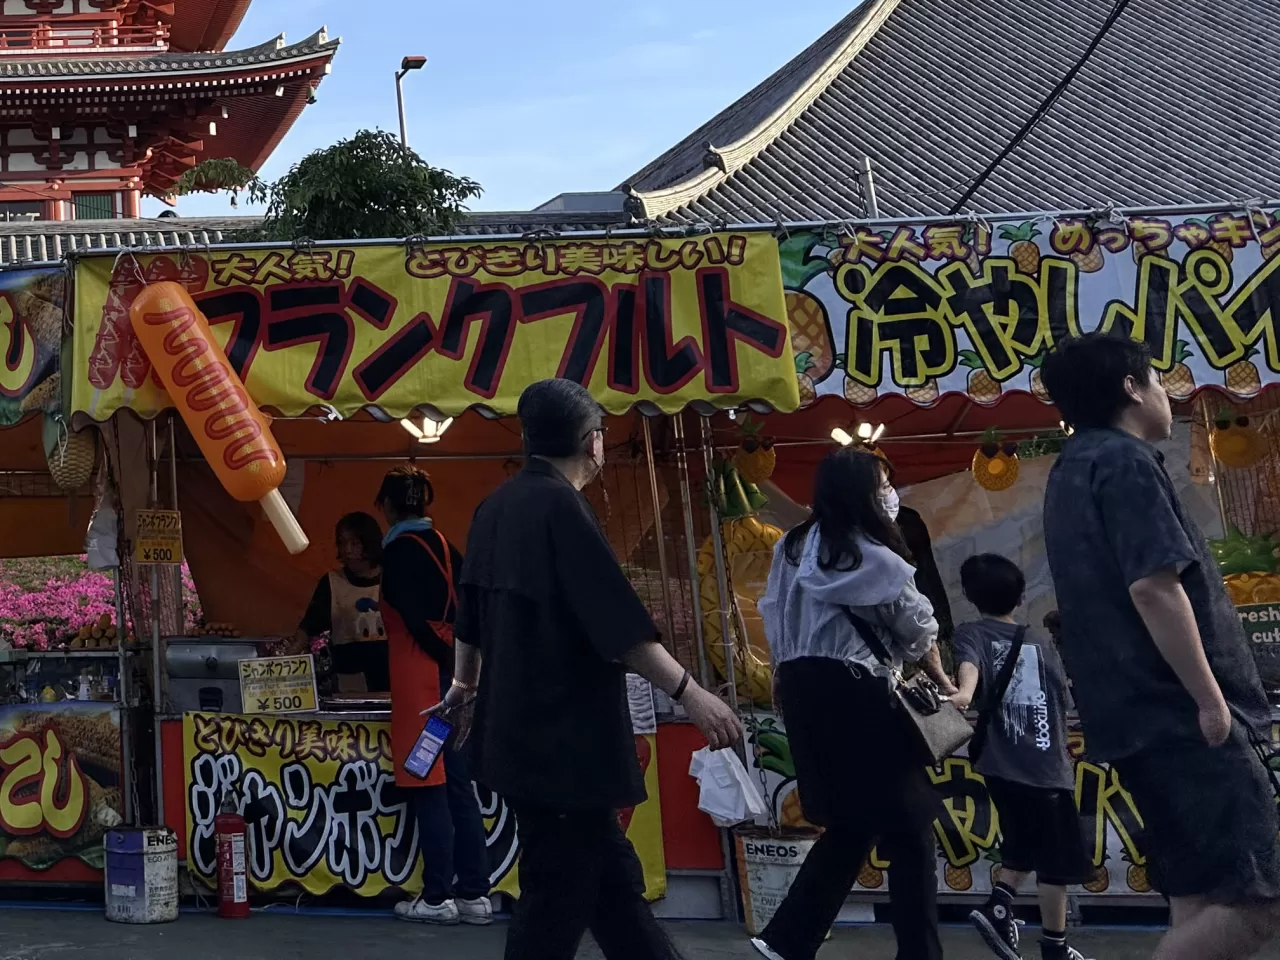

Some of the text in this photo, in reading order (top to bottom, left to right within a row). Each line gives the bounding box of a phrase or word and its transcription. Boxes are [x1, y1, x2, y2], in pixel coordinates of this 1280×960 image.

[194, 266, 787, 402] フランクフルト
[242, 659, 308, 679] ジャンボフランク
[745, 843, 799, 858] ENEOS
